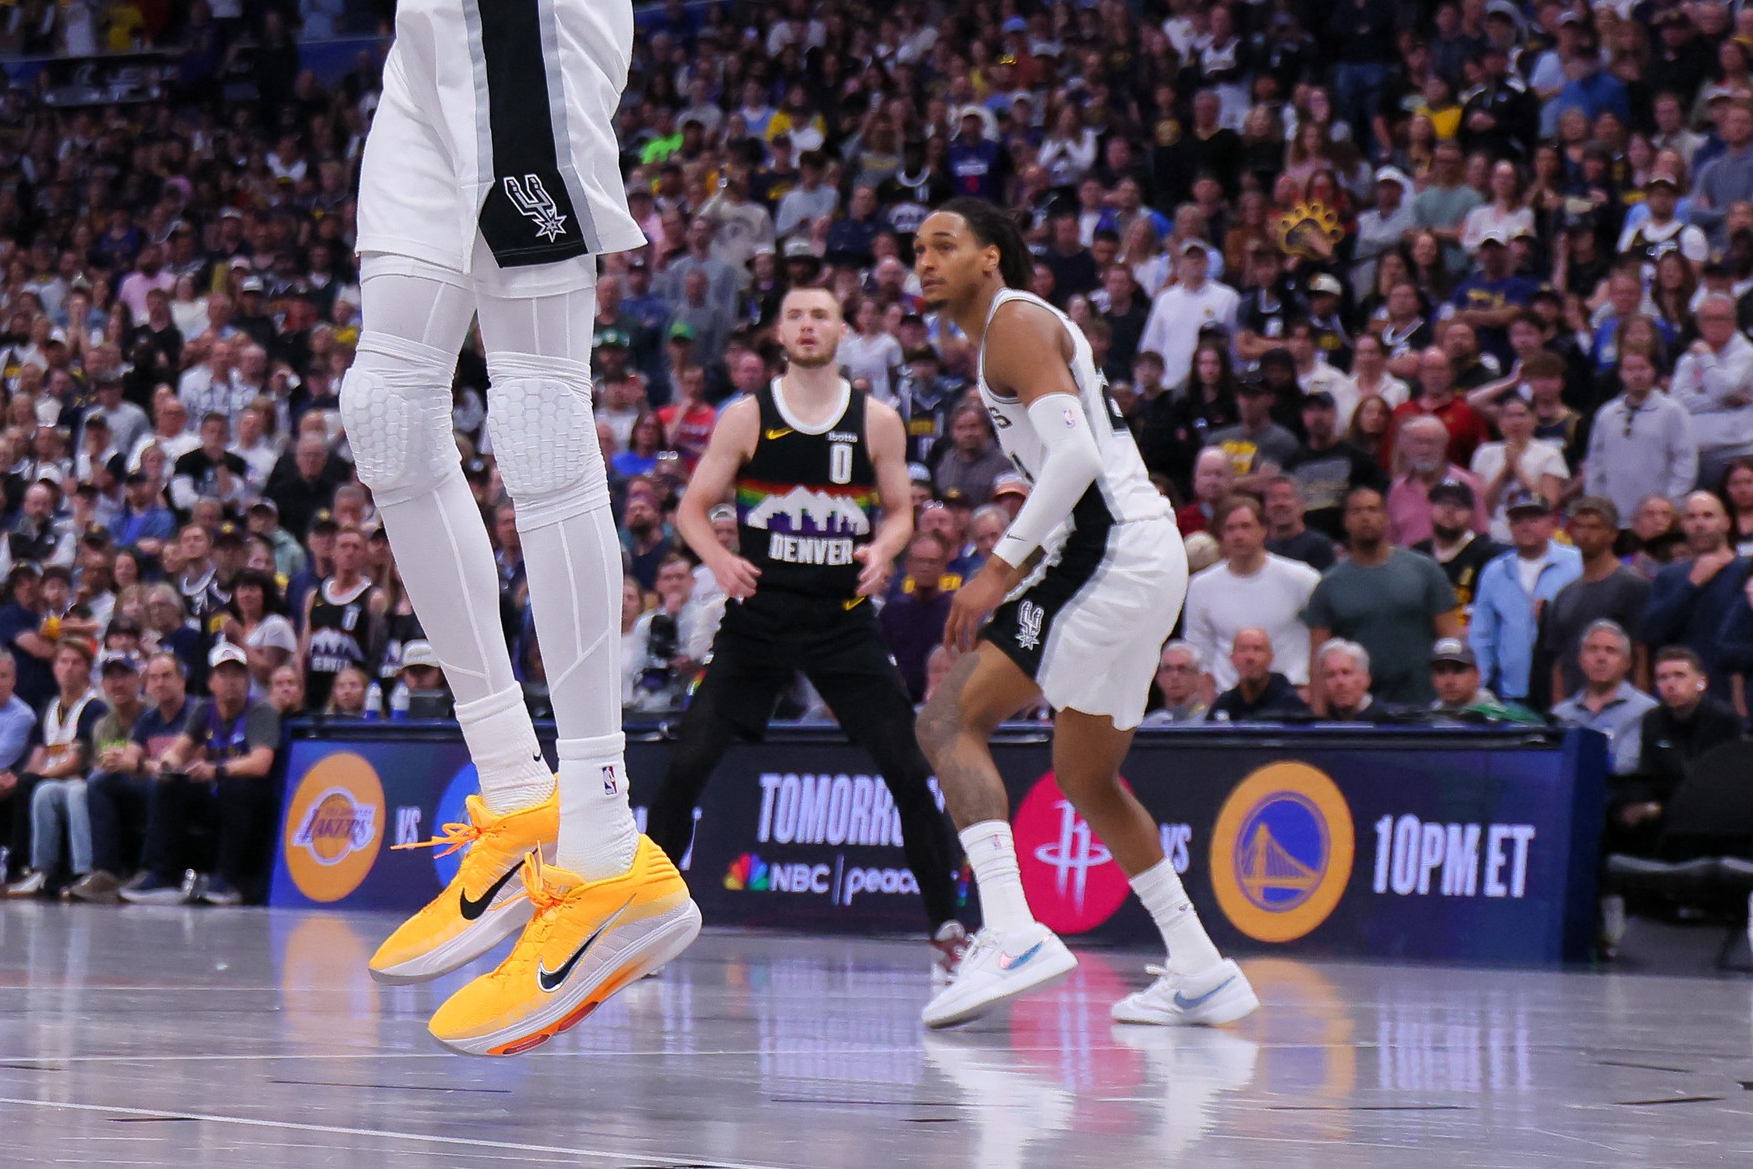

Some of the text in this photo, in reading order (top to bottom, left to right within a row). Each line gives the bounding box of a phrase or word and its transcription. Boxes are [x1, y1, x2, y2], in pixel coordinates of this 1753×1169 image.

[829, 442, 853, 485] 0
[768, 533, 854, 566] DENVER
[757, 773, 945, 847] TOMORR
[1372, 813, 1536, 898] 10PM ET
[769, 862, 829, 893] NBC
